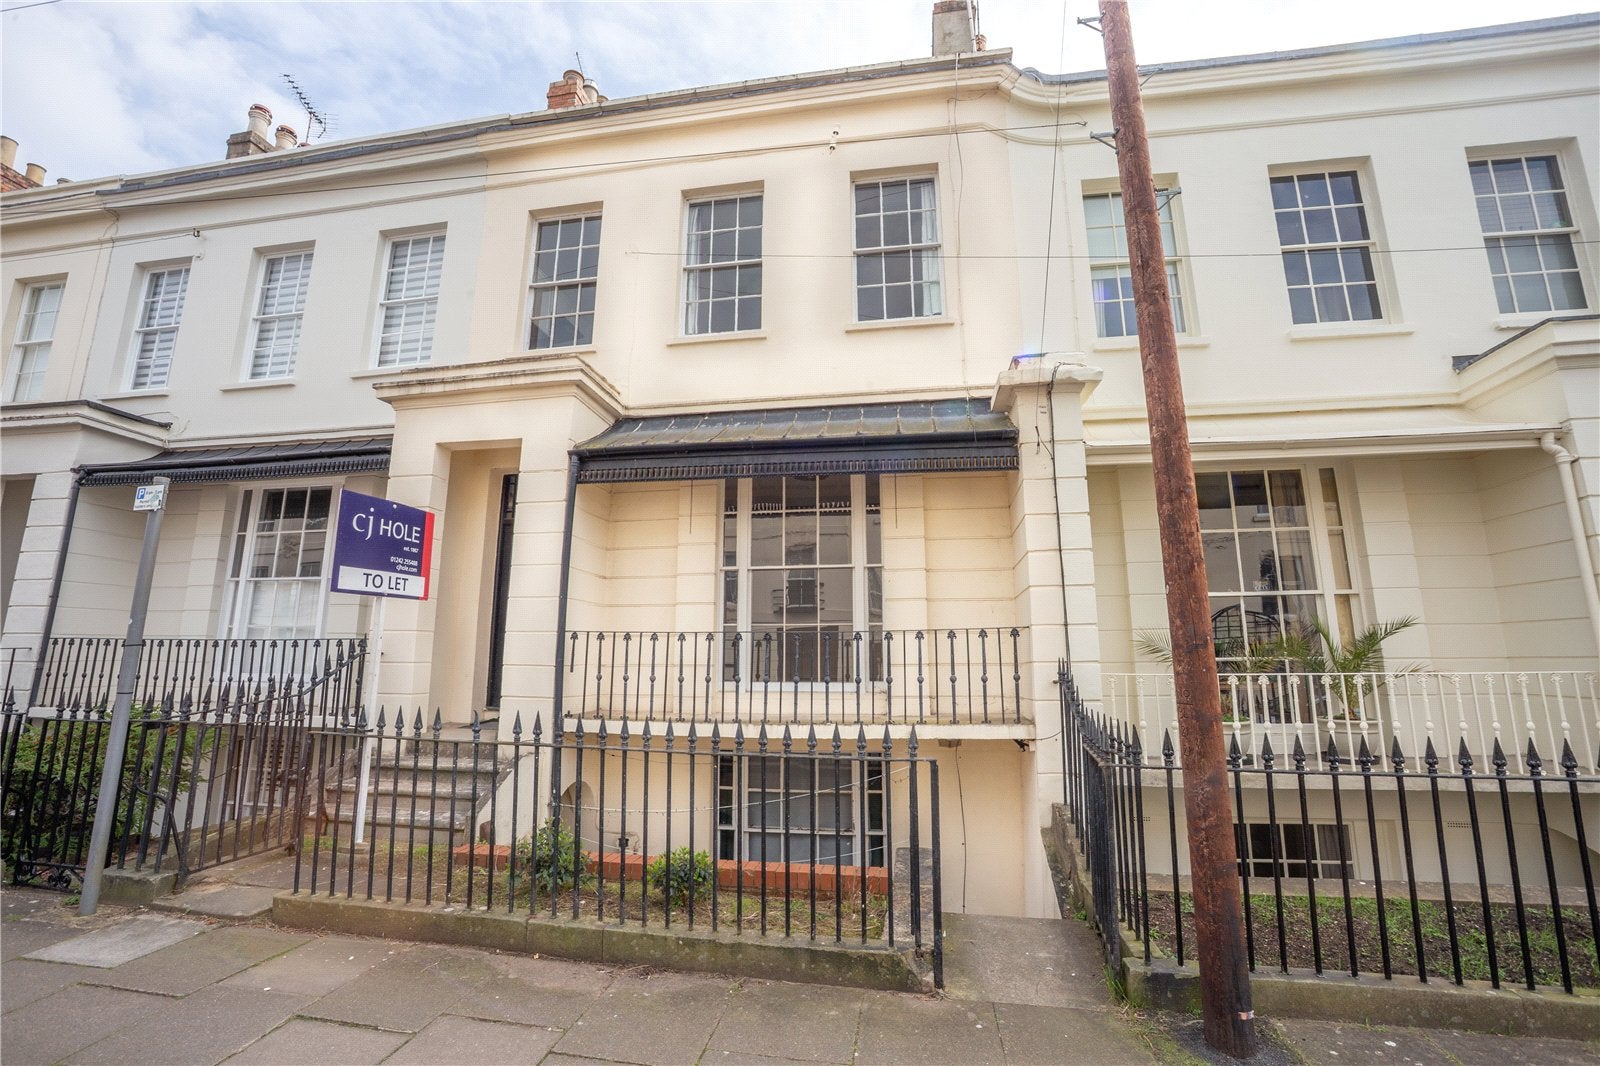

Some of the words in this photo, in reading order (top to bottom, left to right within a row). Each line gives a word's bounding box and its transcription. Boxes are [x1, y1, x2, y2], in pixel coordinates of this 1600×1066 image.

[138, 489, 145, 499] P
[379, 518, 421, 543] HOLE
[390, 556, 404, 564] 01242
[396, 564, 418, 573] cjhole.com
[363, 572, 383, 588] TO
[388, 575, 409, 592] LET
